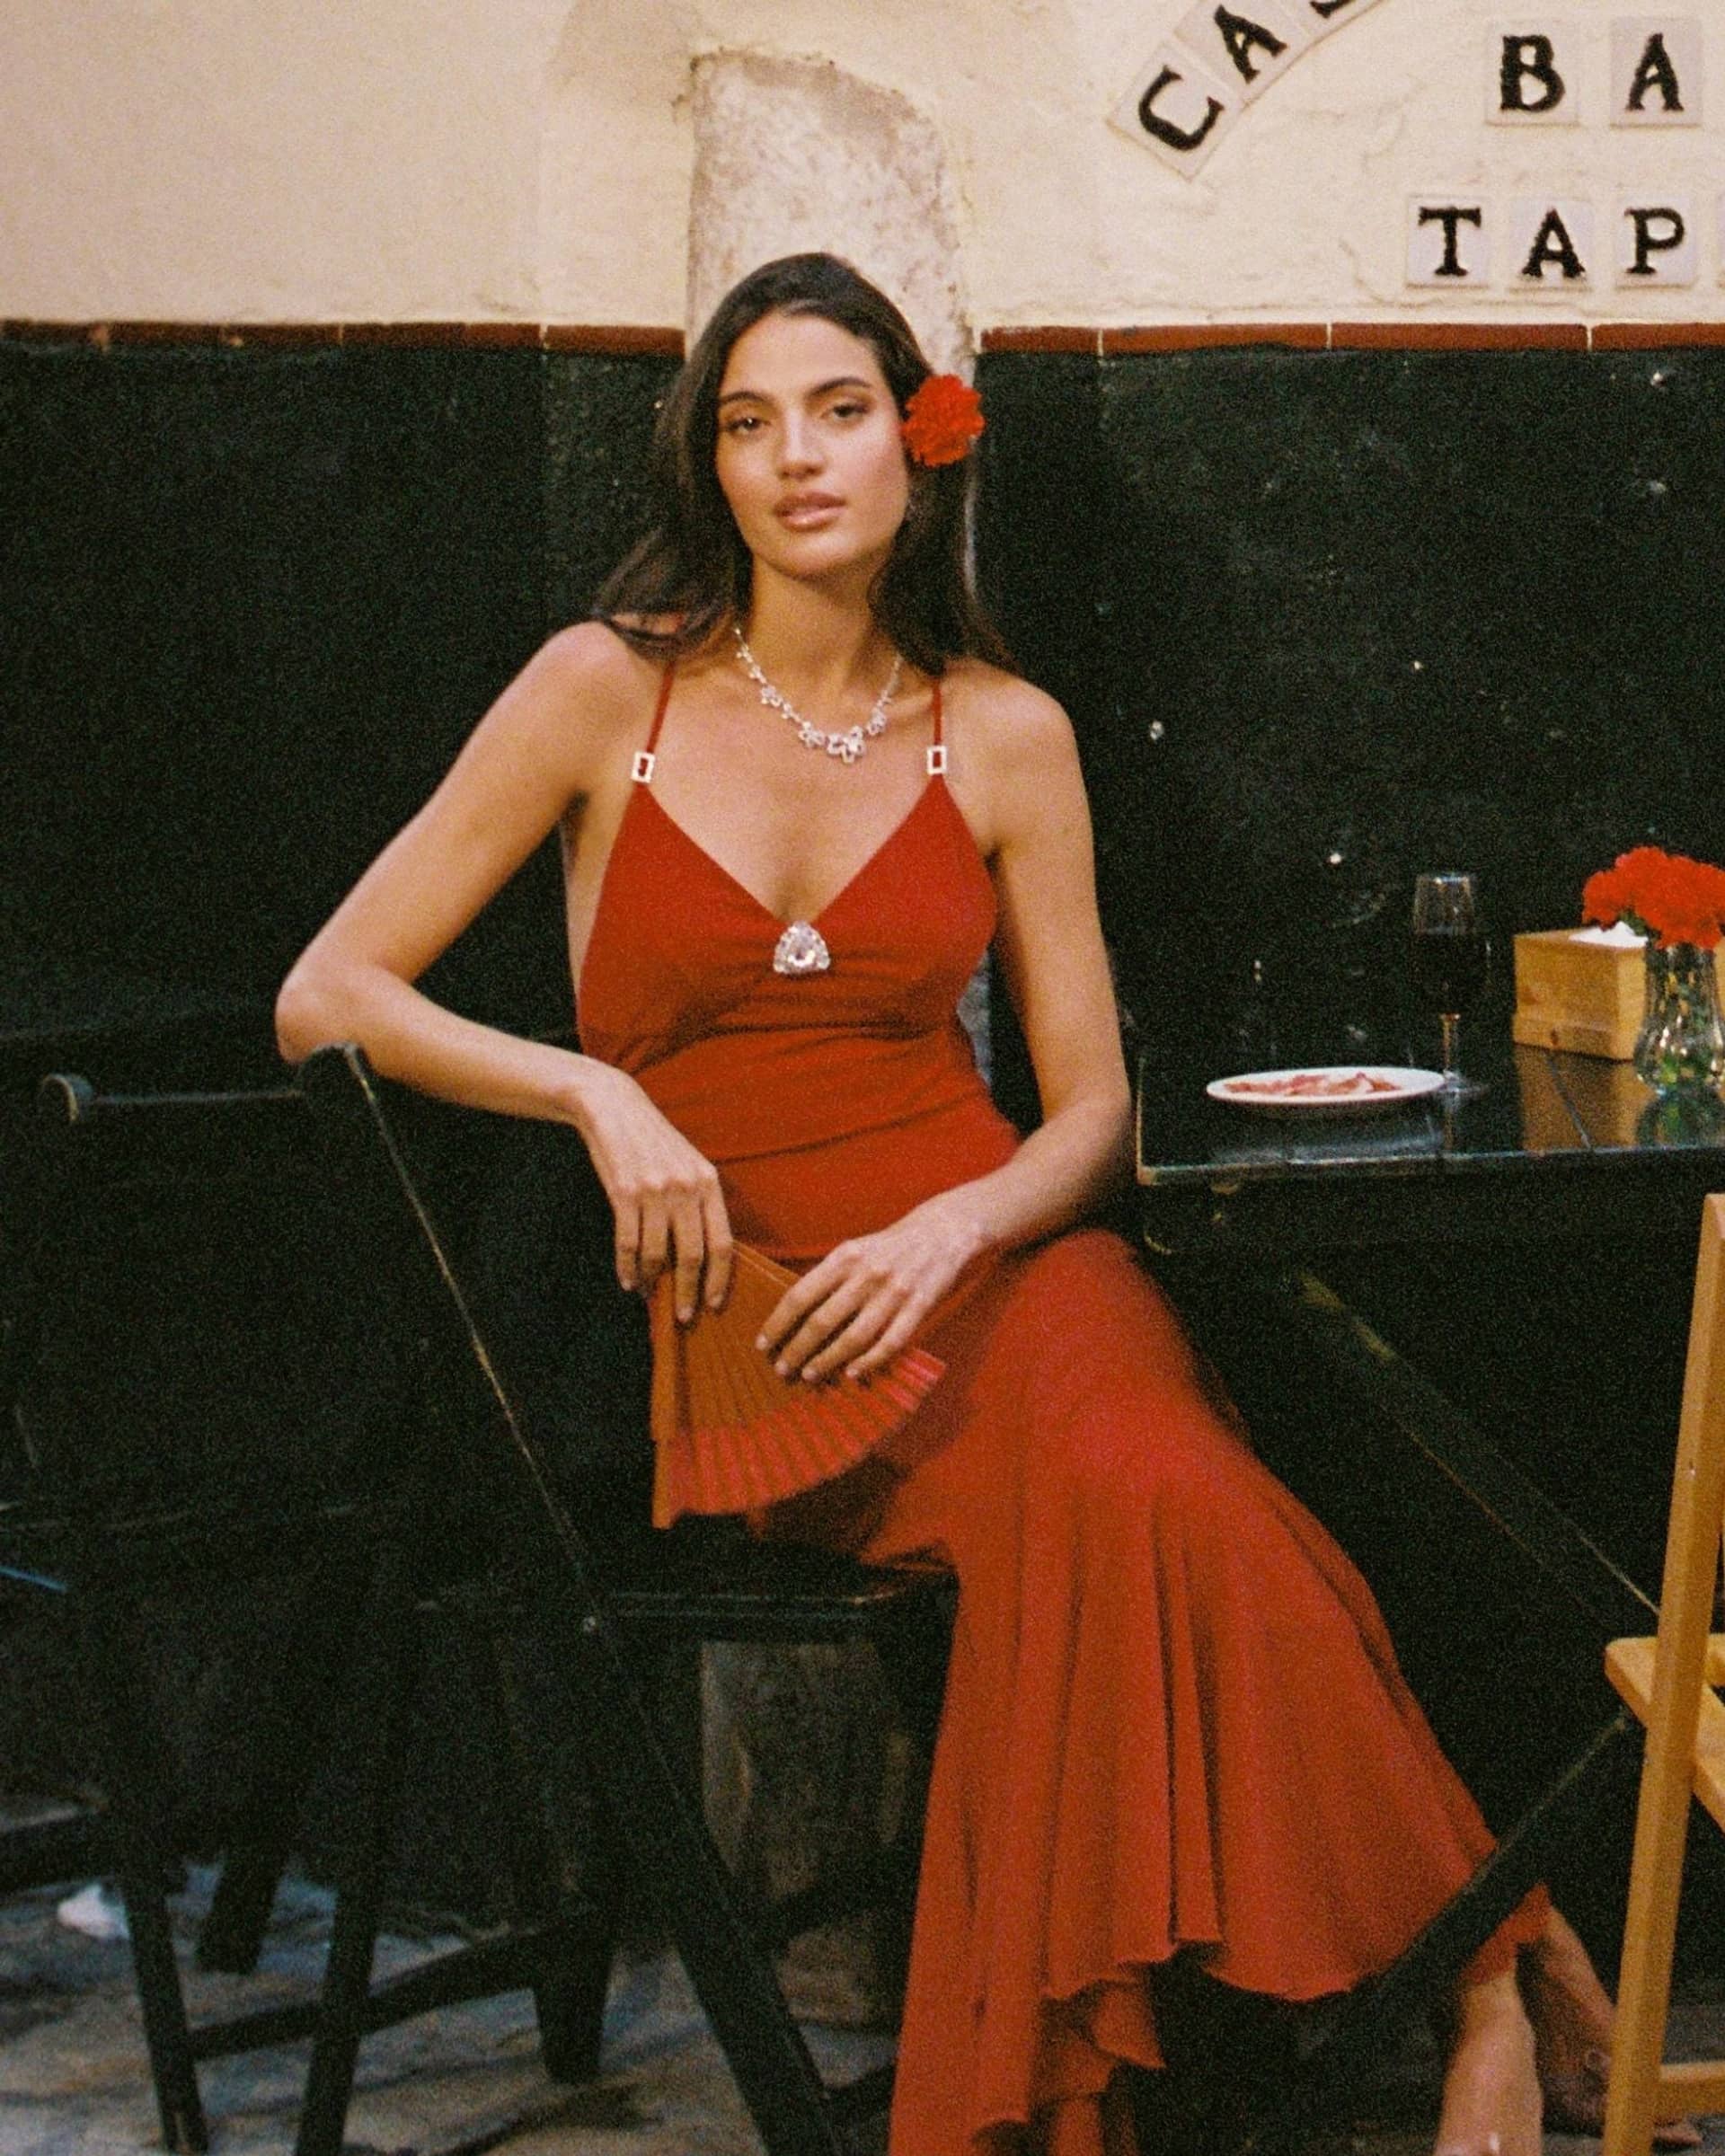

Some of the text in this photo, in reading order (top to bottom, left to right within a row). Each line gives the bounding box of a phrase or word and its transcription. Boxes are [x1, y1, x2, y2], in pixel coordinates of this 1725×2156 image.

[1137, 0, 1352, 152] CA
[1499, 32, 1685, 113] BA
[1418, 205, 1685, 279] TAP
